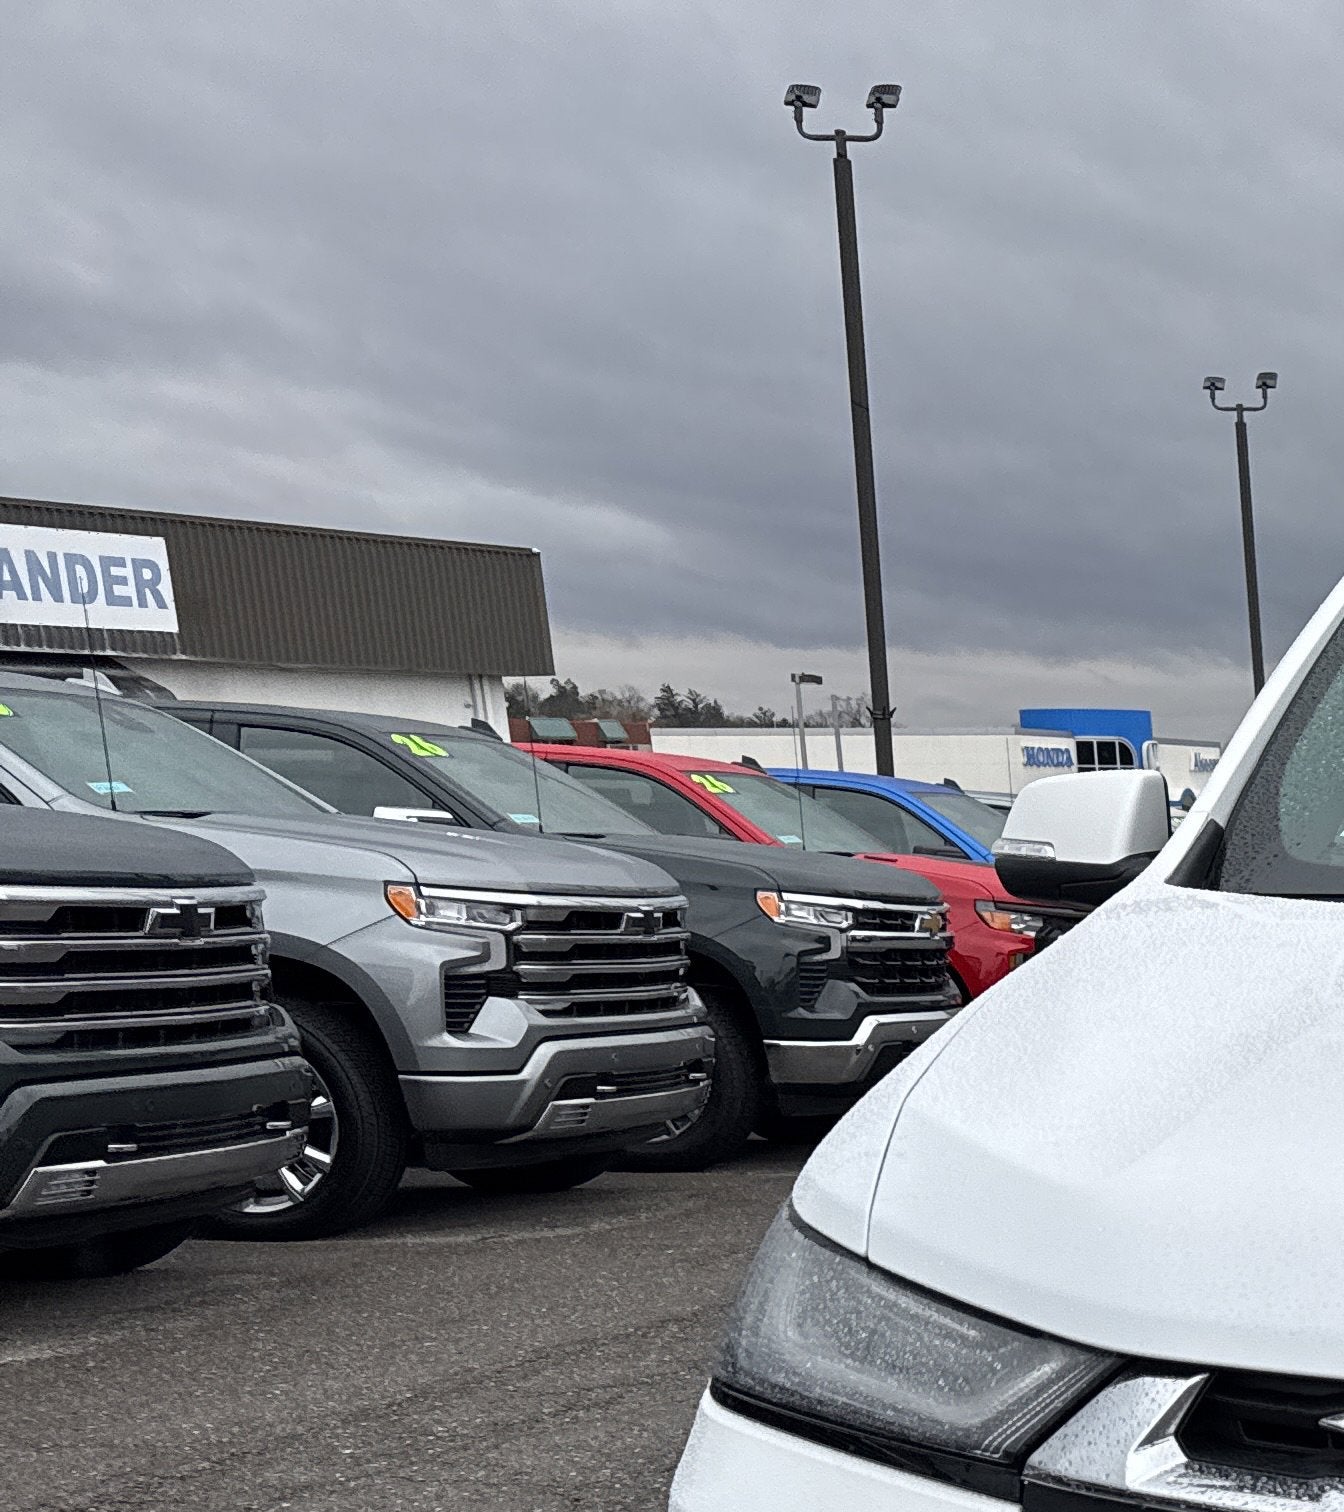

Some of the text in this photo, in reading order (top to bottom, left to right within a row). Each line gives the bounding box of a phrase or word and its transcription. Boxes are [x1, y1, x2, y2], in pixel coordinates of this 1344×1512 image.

[0, 548, 169, 610] ANDER
[391, 733, 450, 757] 26
[1023, 746, 1074, 768] HONDA
[691, 773, 737, 794] 26
